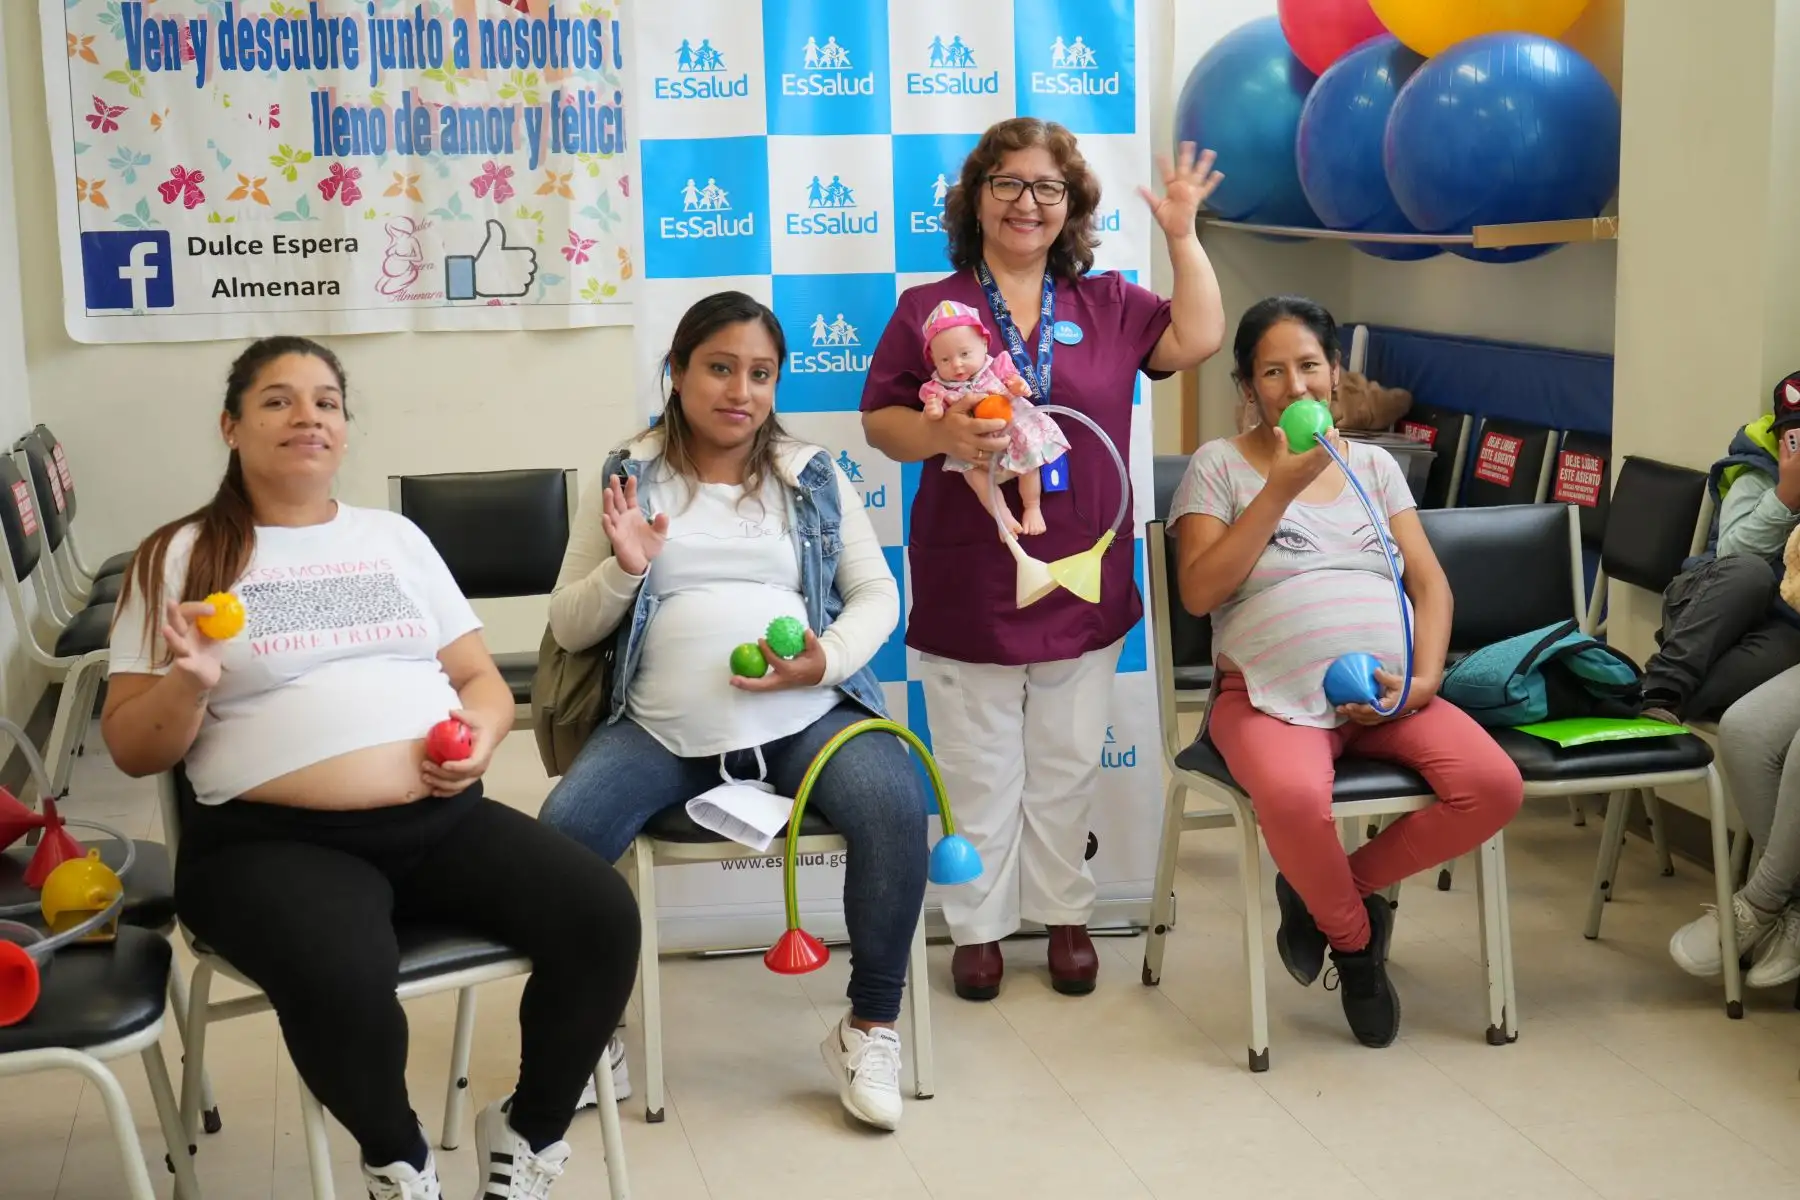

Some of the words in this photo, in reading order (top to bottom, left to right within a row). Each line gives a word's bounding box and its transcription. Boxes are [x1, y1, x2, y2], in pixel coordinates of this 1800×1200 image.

[121, 1, 182, 72] Ven
[189, 19, 208, 89] y
[217, 1, 359, 72] descubre
[367, 1, 444, 88] junto
[453, 18, 470, 69] a
[478, 4, 603, 70] nosotros
[655, 74, 748, 99] EsSalud
[782, 72, 874, 97] EsSalud
[907, 71, 998, 95] EsSalud
[1032, 71, 1119, 96] EsSalud
[310, 91, 387, 156] lleno
[394, 91, 431, 156] de
[440, 105, 514, 155] amor
[524, 106, 543, 170] y
[660, 212, 754, 239] EsSalud
[787, 211, 878, 235] EsSalud
[187, 235, 263, 256] Dulce
[272, 234, 359, 258] Espera
[211, 277, 341, 298] Almenara
[246, 567, 285, 582] ESS
[289, 558, 393, 579] MONDAYS
[250, 635, 324, 657] MORE
[333, 622, 428, 646] FRIDAYS
